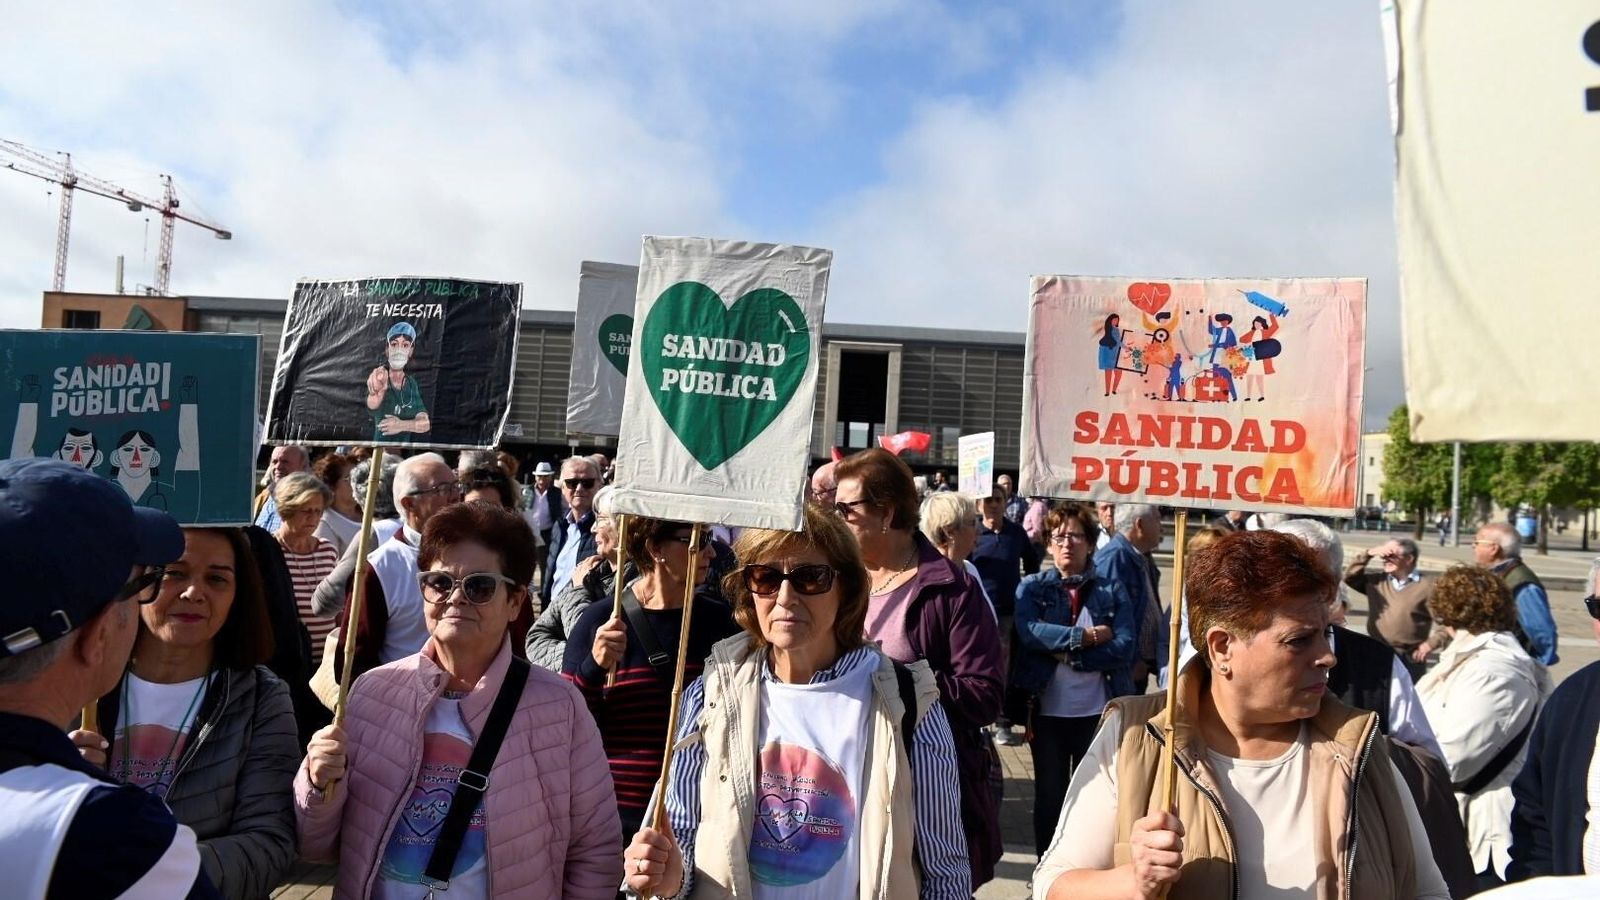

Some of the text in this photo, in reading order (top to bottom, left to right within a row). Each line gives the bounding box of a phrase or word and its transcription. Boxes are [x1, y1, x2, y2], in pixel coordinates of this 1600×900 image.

[343, 280, 359, 298] LA
[366, 279, 421, 297] SANIDAD
[366, 302, 443, 320] TE NECESITA
[661, 333, 786, 367] SANIDAD
[52, 362, 161, 390] SANIDAD
[660, 363, 778, 401] PÚBLICA
[50, 386, 160, 418] PÚBLICA
[1073, 410, 1307, 454] SANIDAD
[1070, 450, 1304, 505] PÚBLICA
